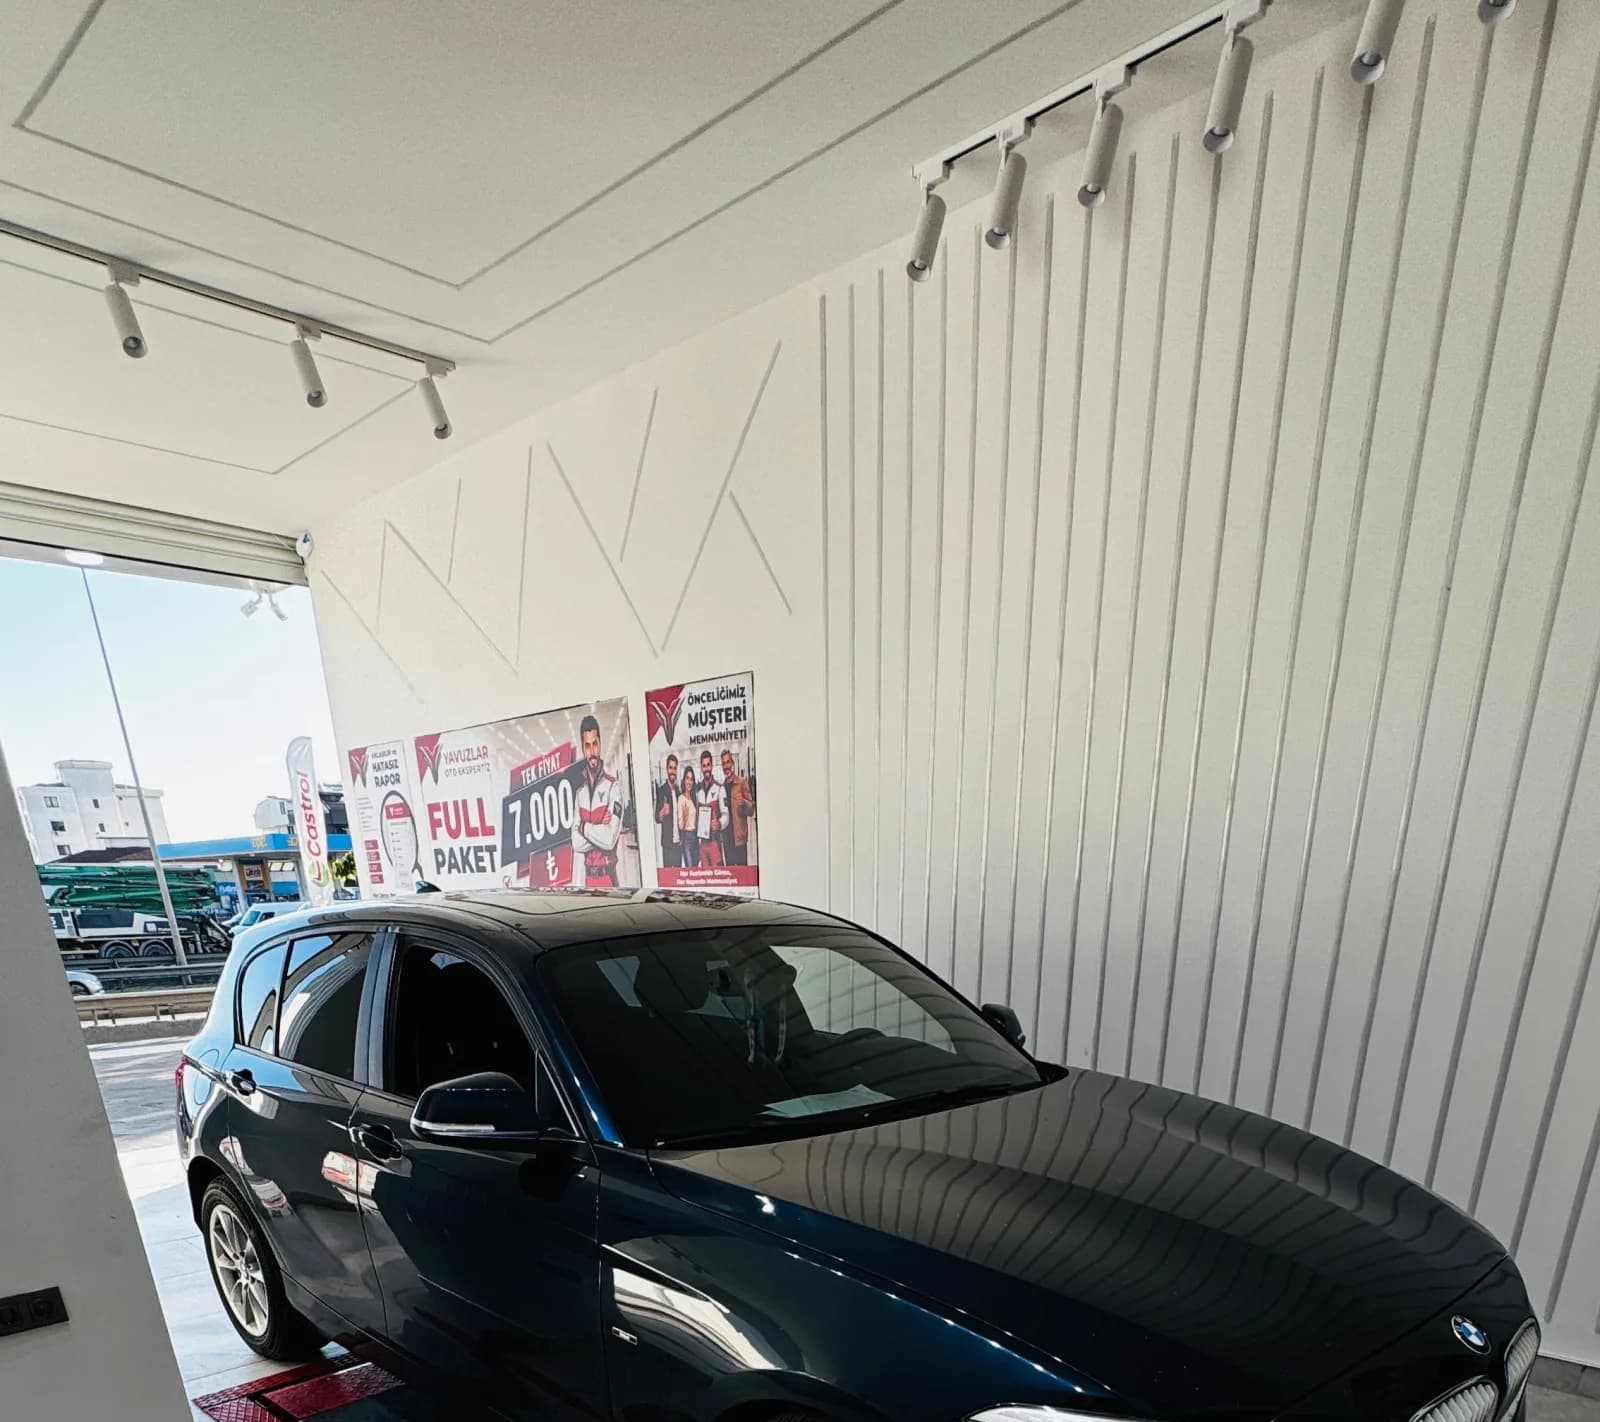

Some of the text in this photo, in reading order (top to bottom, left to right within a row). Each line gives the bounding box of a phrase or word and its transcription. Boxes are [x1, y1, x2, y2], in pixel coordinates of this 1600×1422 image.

[687, 683, 746, 706] ÖNCELİĞİMİZ
[687, 699, 747, 730] MÜŞTERİ
[689, 725, 747, 746] MEMNUNİYETİ
[443, 745, 489, 765] YAVUZLAR
[521, 752, 561, 787] TEK FİYAT
[374, 773, 401, 788] RAPOR
[445, 768, 458, 779] OTO
[296, 770, 321, 857] Castrol
[427, 797, 496, 841] FULL
[508, 779, 574, 849] 7.000
[433, 844, 498, 875] PAKET
